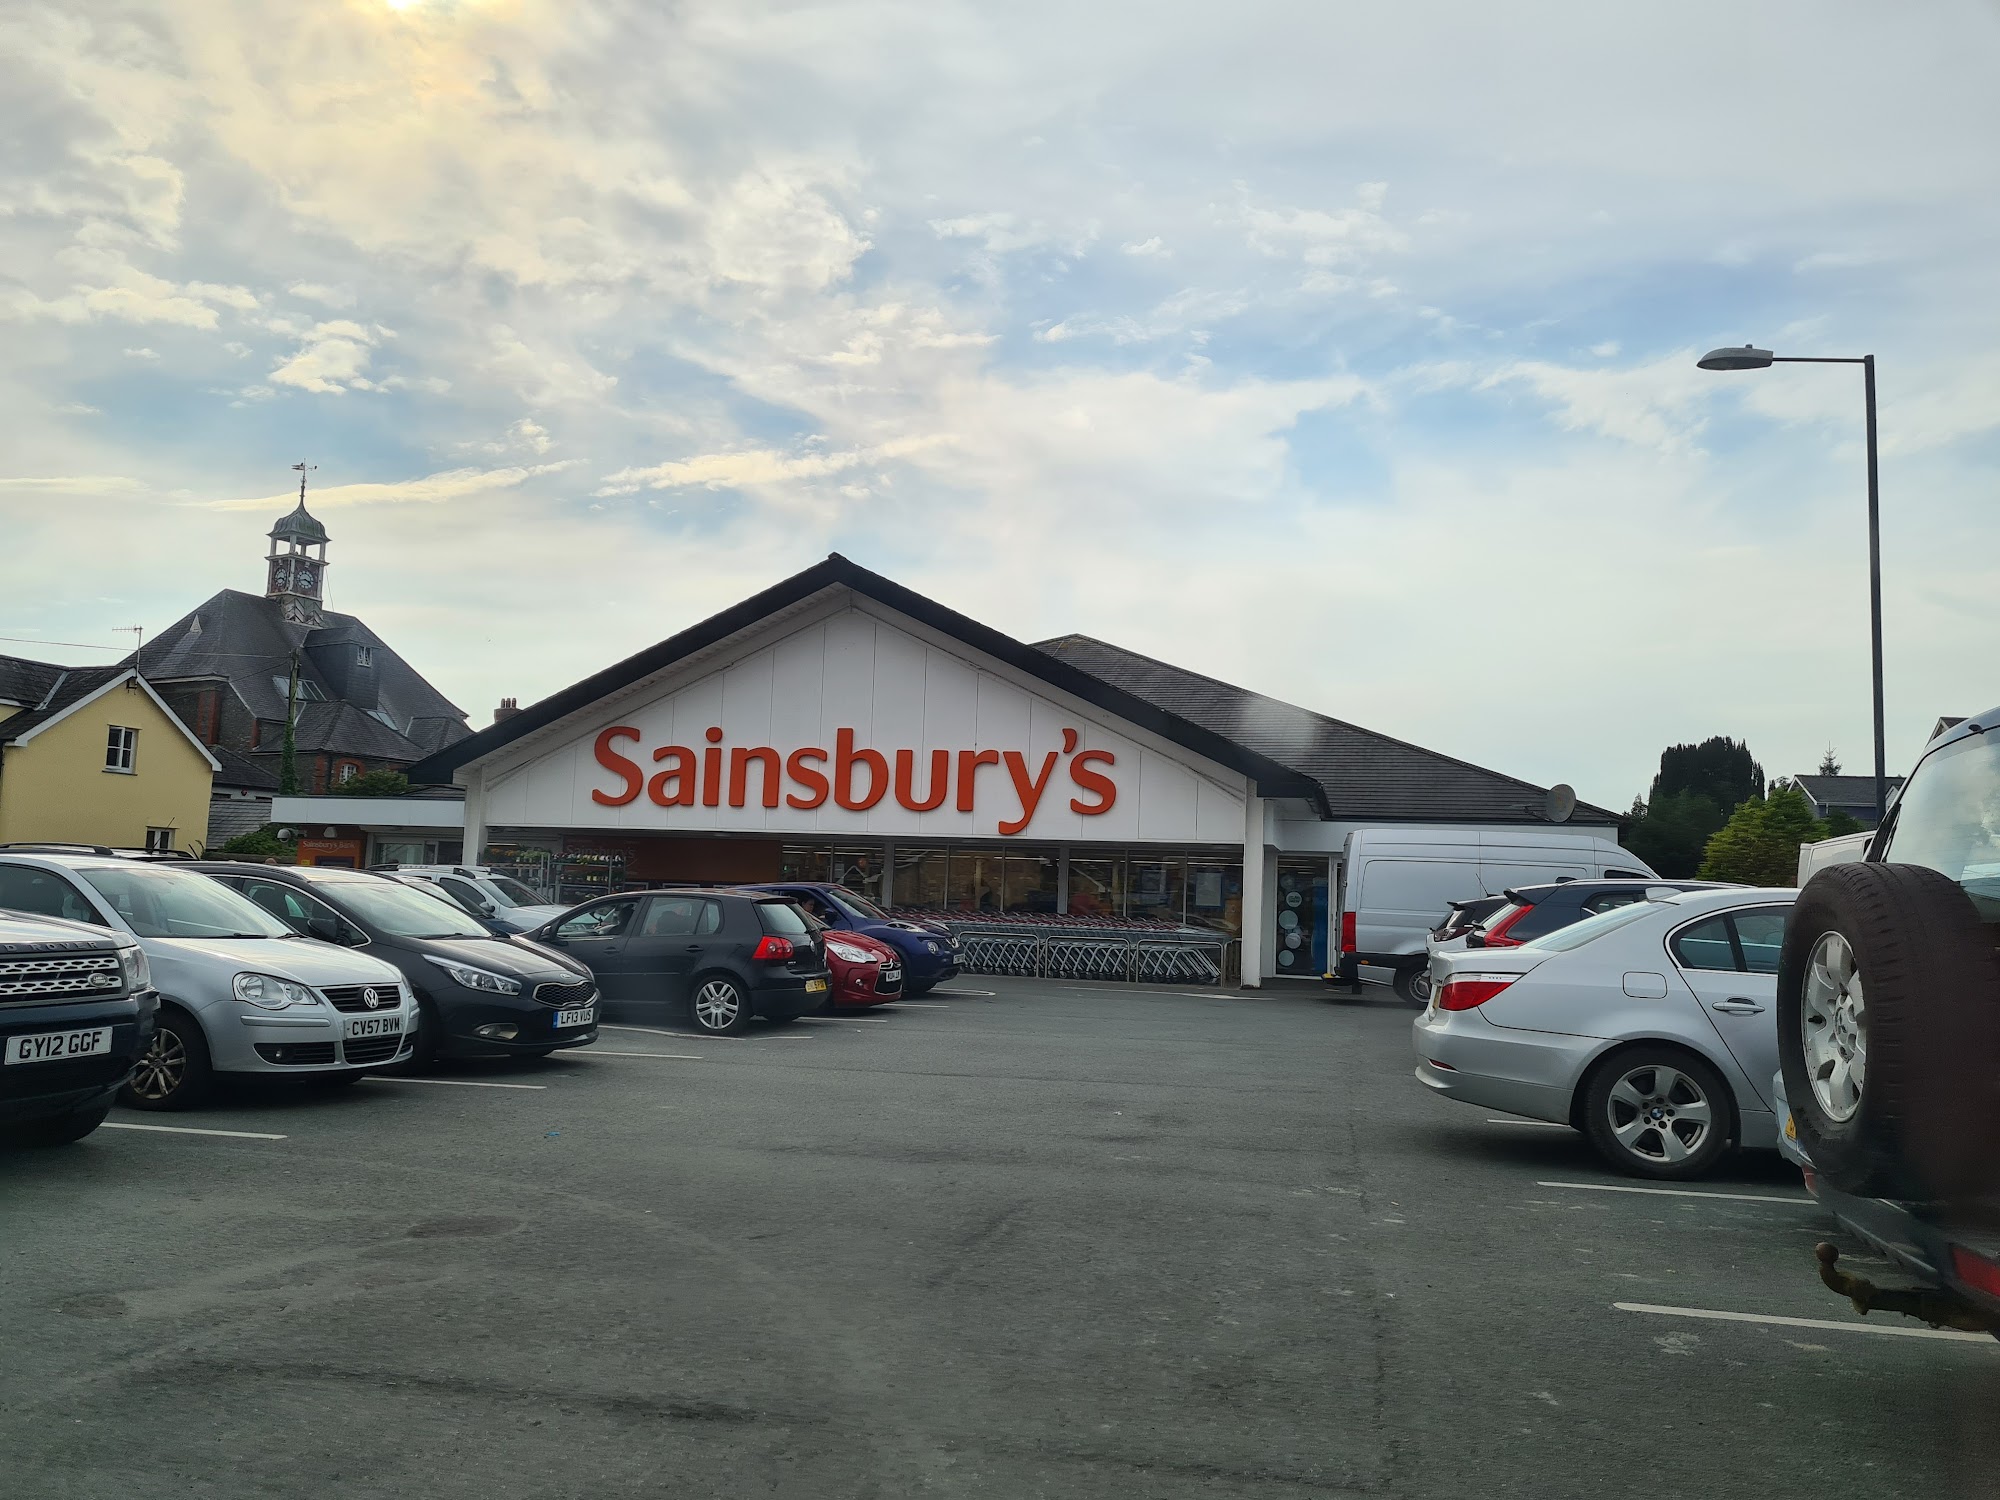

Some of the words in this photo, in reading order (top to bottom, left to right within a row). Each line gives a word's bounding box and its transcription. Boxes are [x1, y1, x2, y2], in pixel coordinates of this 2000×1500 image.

[592, 726, 1117, 834] Sainsbury's
[28, 941, 99, 951] ROVER
[352, 1020, 380, 1036] CV57
[382, 1017, 400, 1033] BVM
[560, 1012, 579, 1024] LF13
[19, 1035, 63, 1059] GY12
[68, 1031, 102, 1054] GGF
